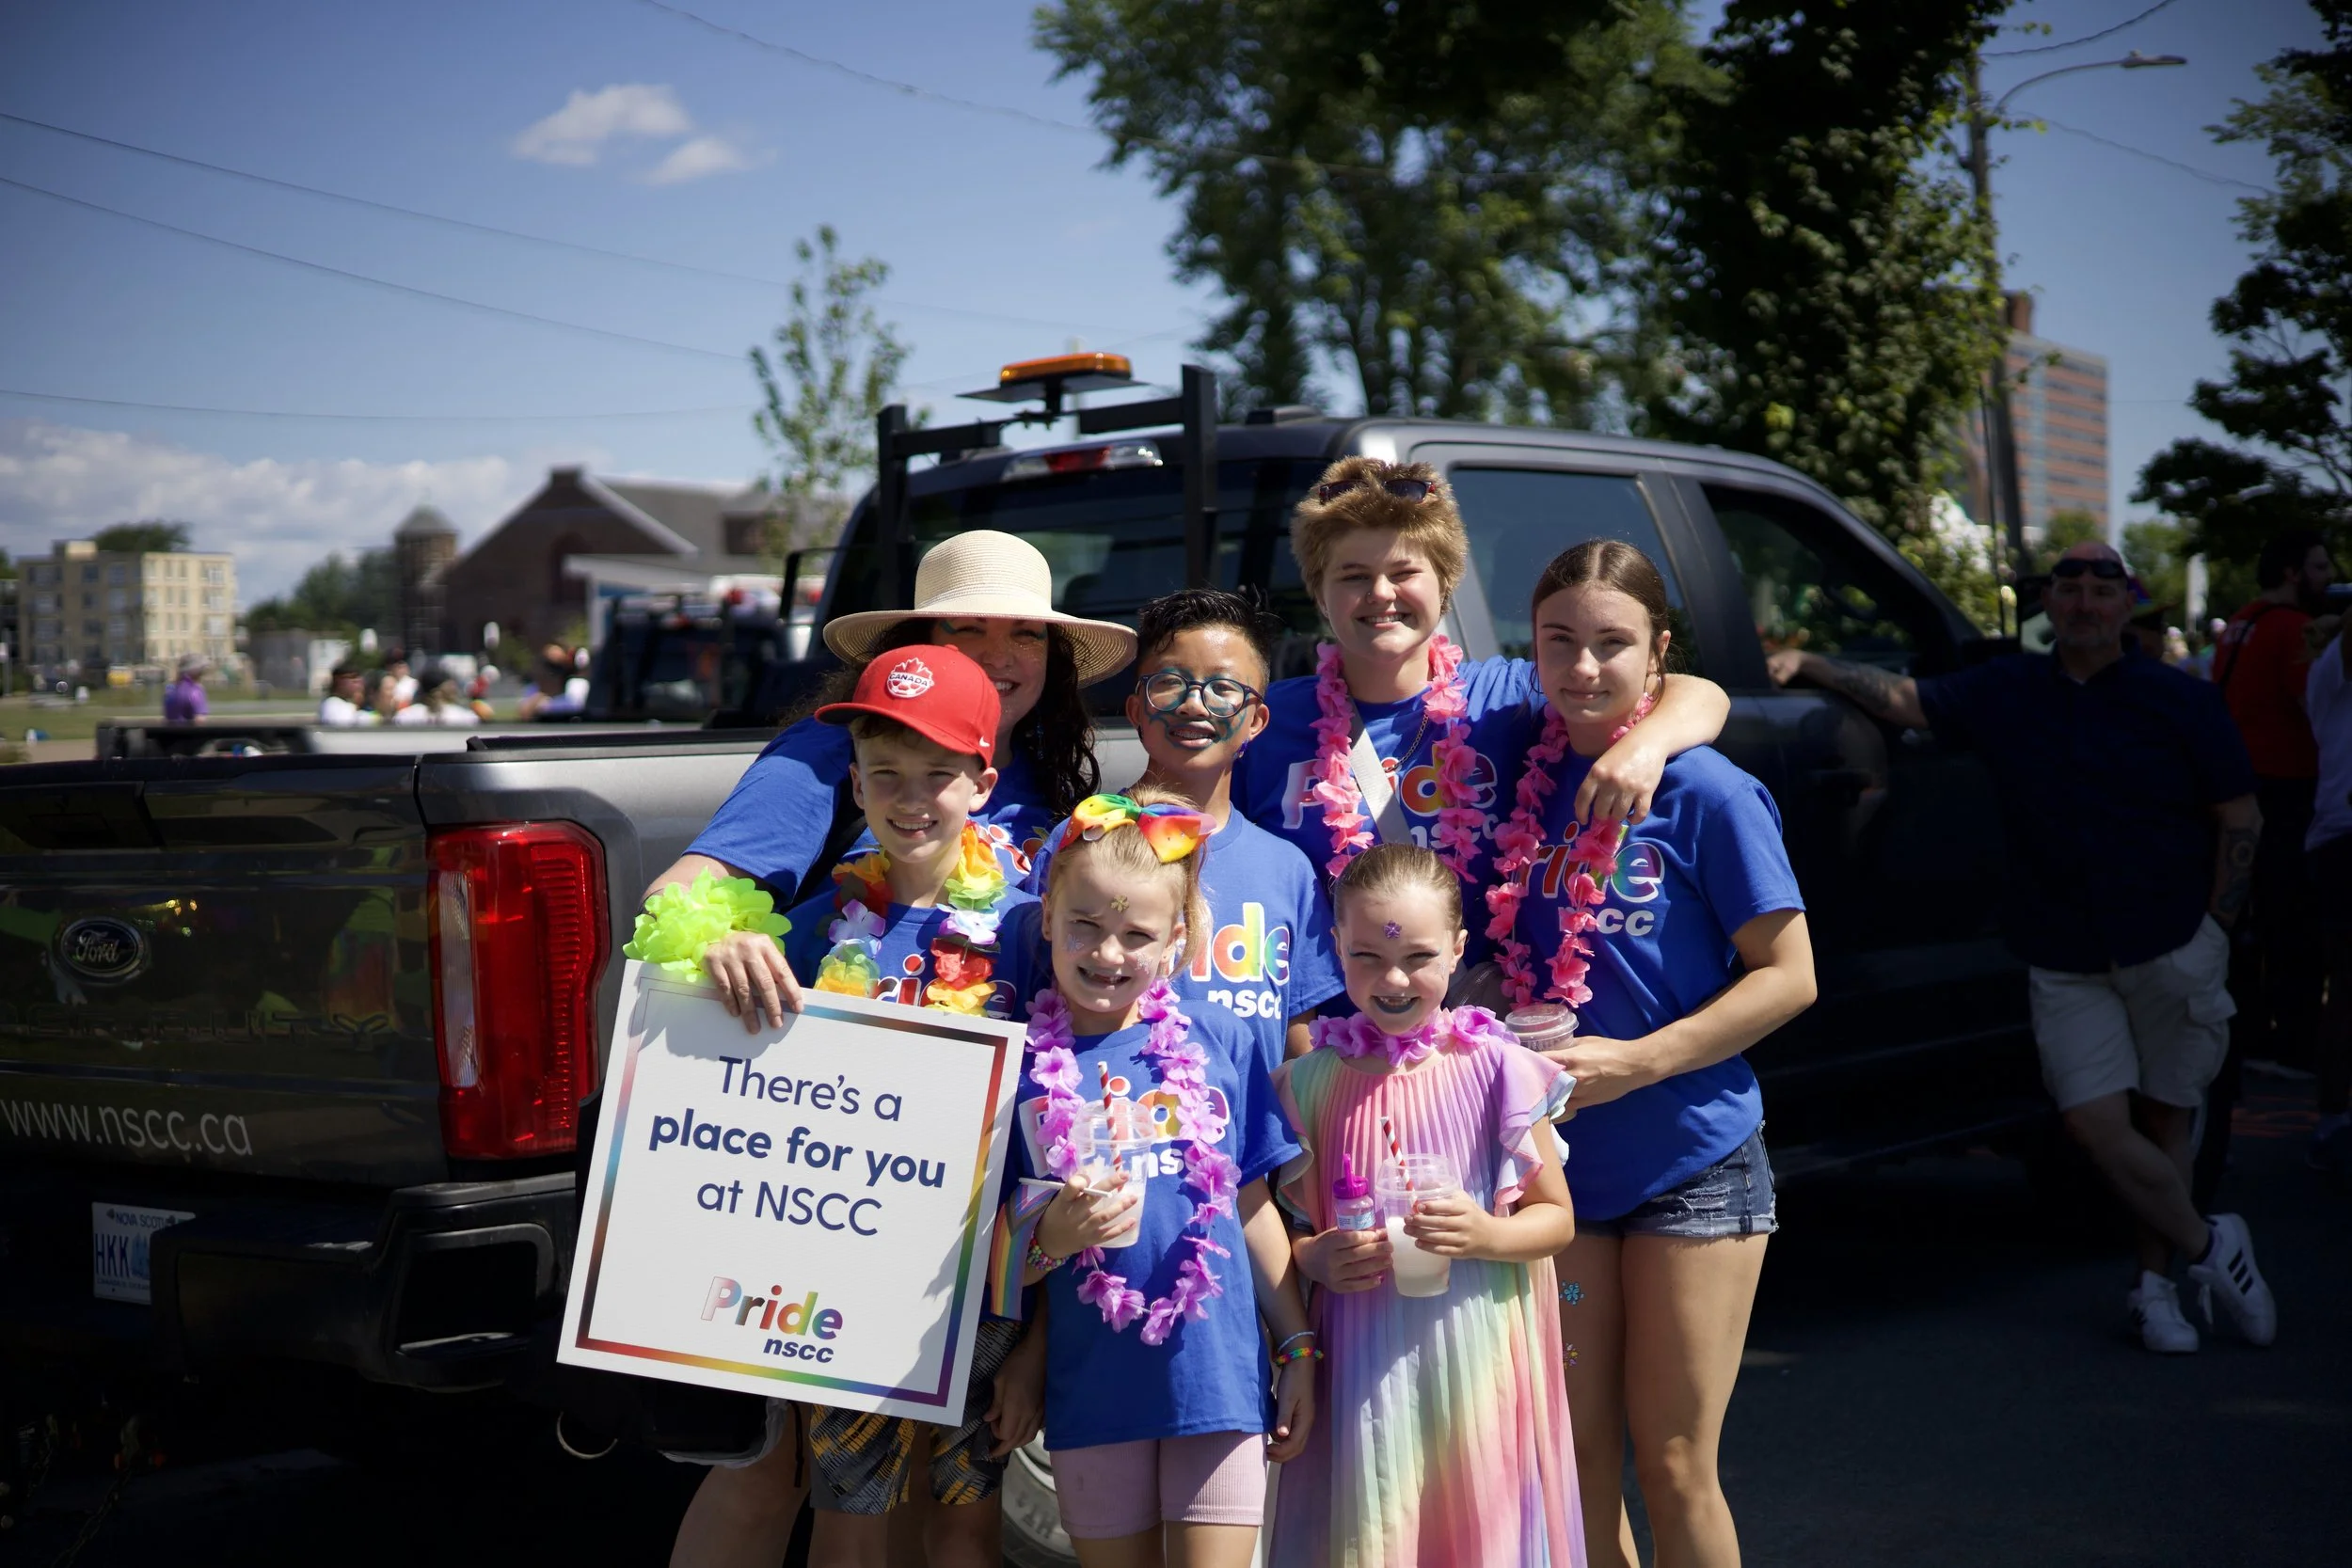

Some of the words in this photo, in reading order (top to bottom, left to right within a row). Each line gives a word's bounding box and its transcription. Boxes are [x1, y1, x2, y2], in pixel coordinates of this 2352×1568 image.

[889, 673, 928, 687] CANADA
[73, 928, 121, 963] Ford
[718, 1055, 860, 1115] There's
[875, 1094, 902, 1122] a
[0, 1099, 252, 1156] www.nscc.ca
[648, 1108, 772, 1159] place
[787, 1127, 854, 1172] for
[866, 1150, 946, 1189] you
[115, 1212, 138, 1227] NOVA
[697, 1180, 744, 1214] at
[755, 1181, 882, 1237] NSCC
[95, 1233, 130, 1277] HKK
[701, 1276, 843, 1340] Pride
[763, 1338, 834, 1364] nscc
